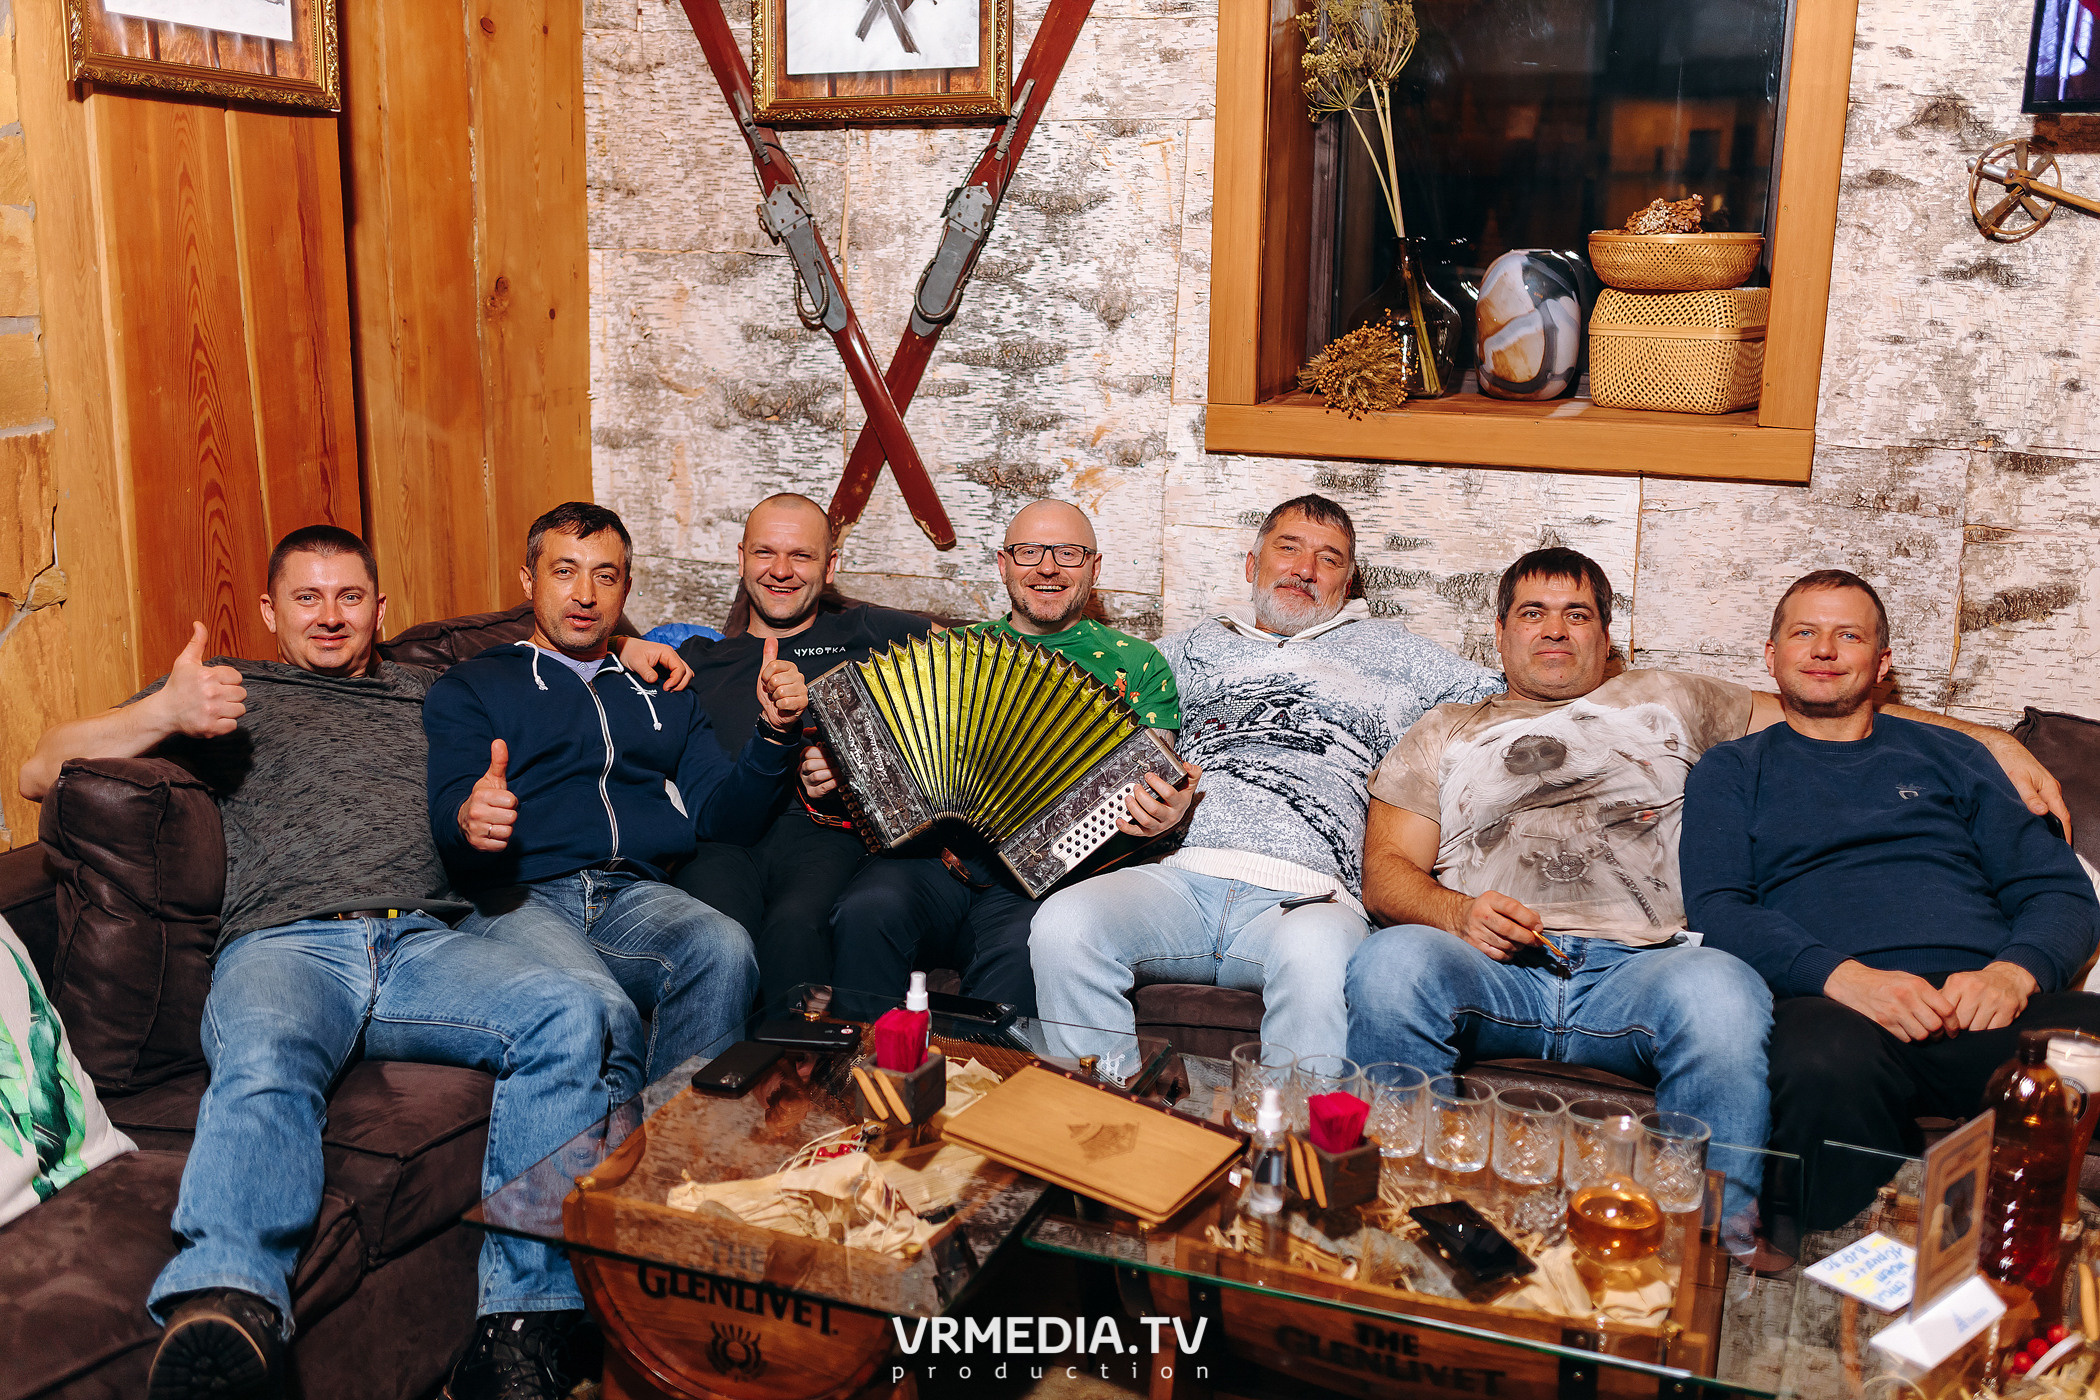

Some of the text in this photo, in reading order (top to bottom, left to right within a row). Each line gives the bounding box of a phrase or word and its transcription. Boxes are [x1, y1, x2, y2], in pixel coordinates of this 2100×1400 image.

[793, 646, 846, 657] ЧУКОТКА
[707, 1238, 767, 1275] THE
[1353, 1321, 1420, 1357] THE
